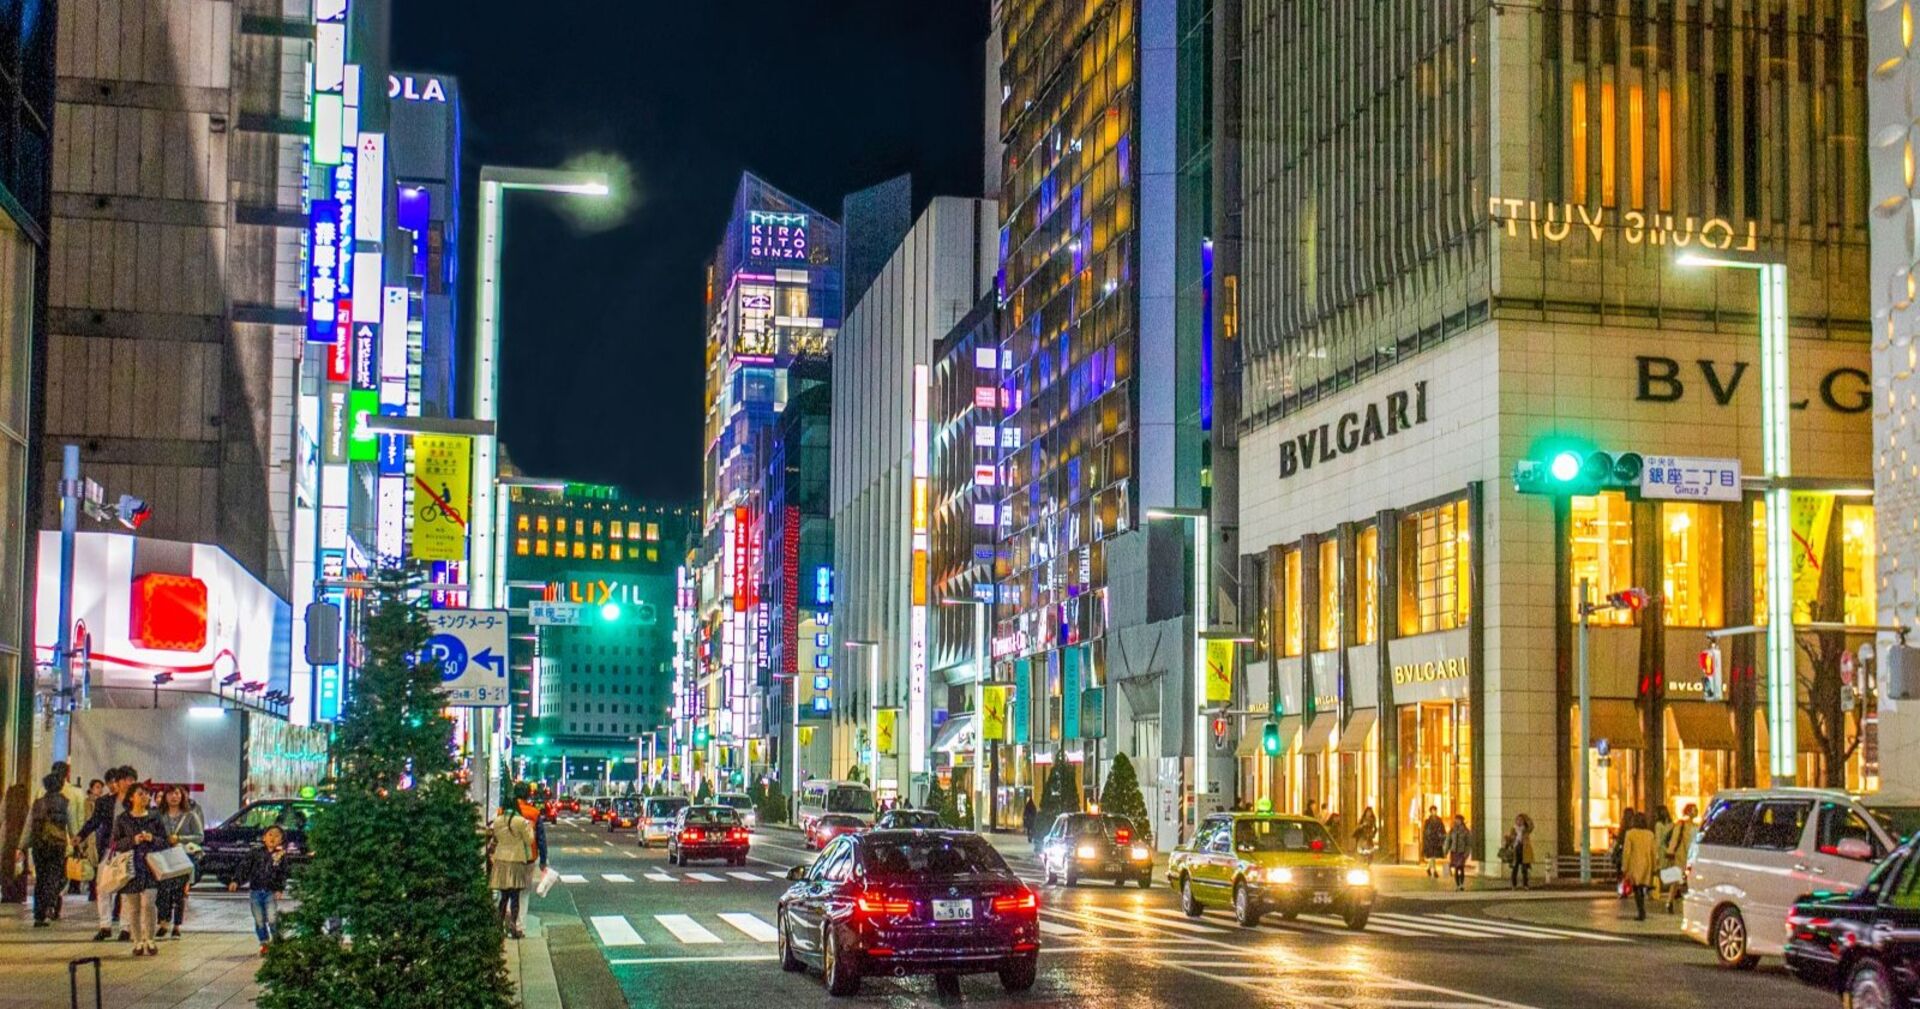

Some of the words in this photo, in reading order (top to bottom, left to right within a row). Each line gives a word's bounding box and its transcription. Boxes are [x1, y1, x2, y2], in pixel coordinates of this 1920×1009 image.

[752, 225, 804, 237] KIRA
[752, 236, 805, 248] RITO
[751, 249, 804, 259] GINZA
[1635, 355, 1873, 414] BVG
[1279, 380, 1428, 479] BVLGARI
[1649, 467, 1734, 487] 銀座二丁目
[1674, 485, 1699, 495] Ginza
[1703, 486, 1709, 495] 2
[571, 580, 644, 605] LIXIL
[428, 615, 503, 629] ーキング・メーター
[1394, 656, 1469, 686] BVLGARI
